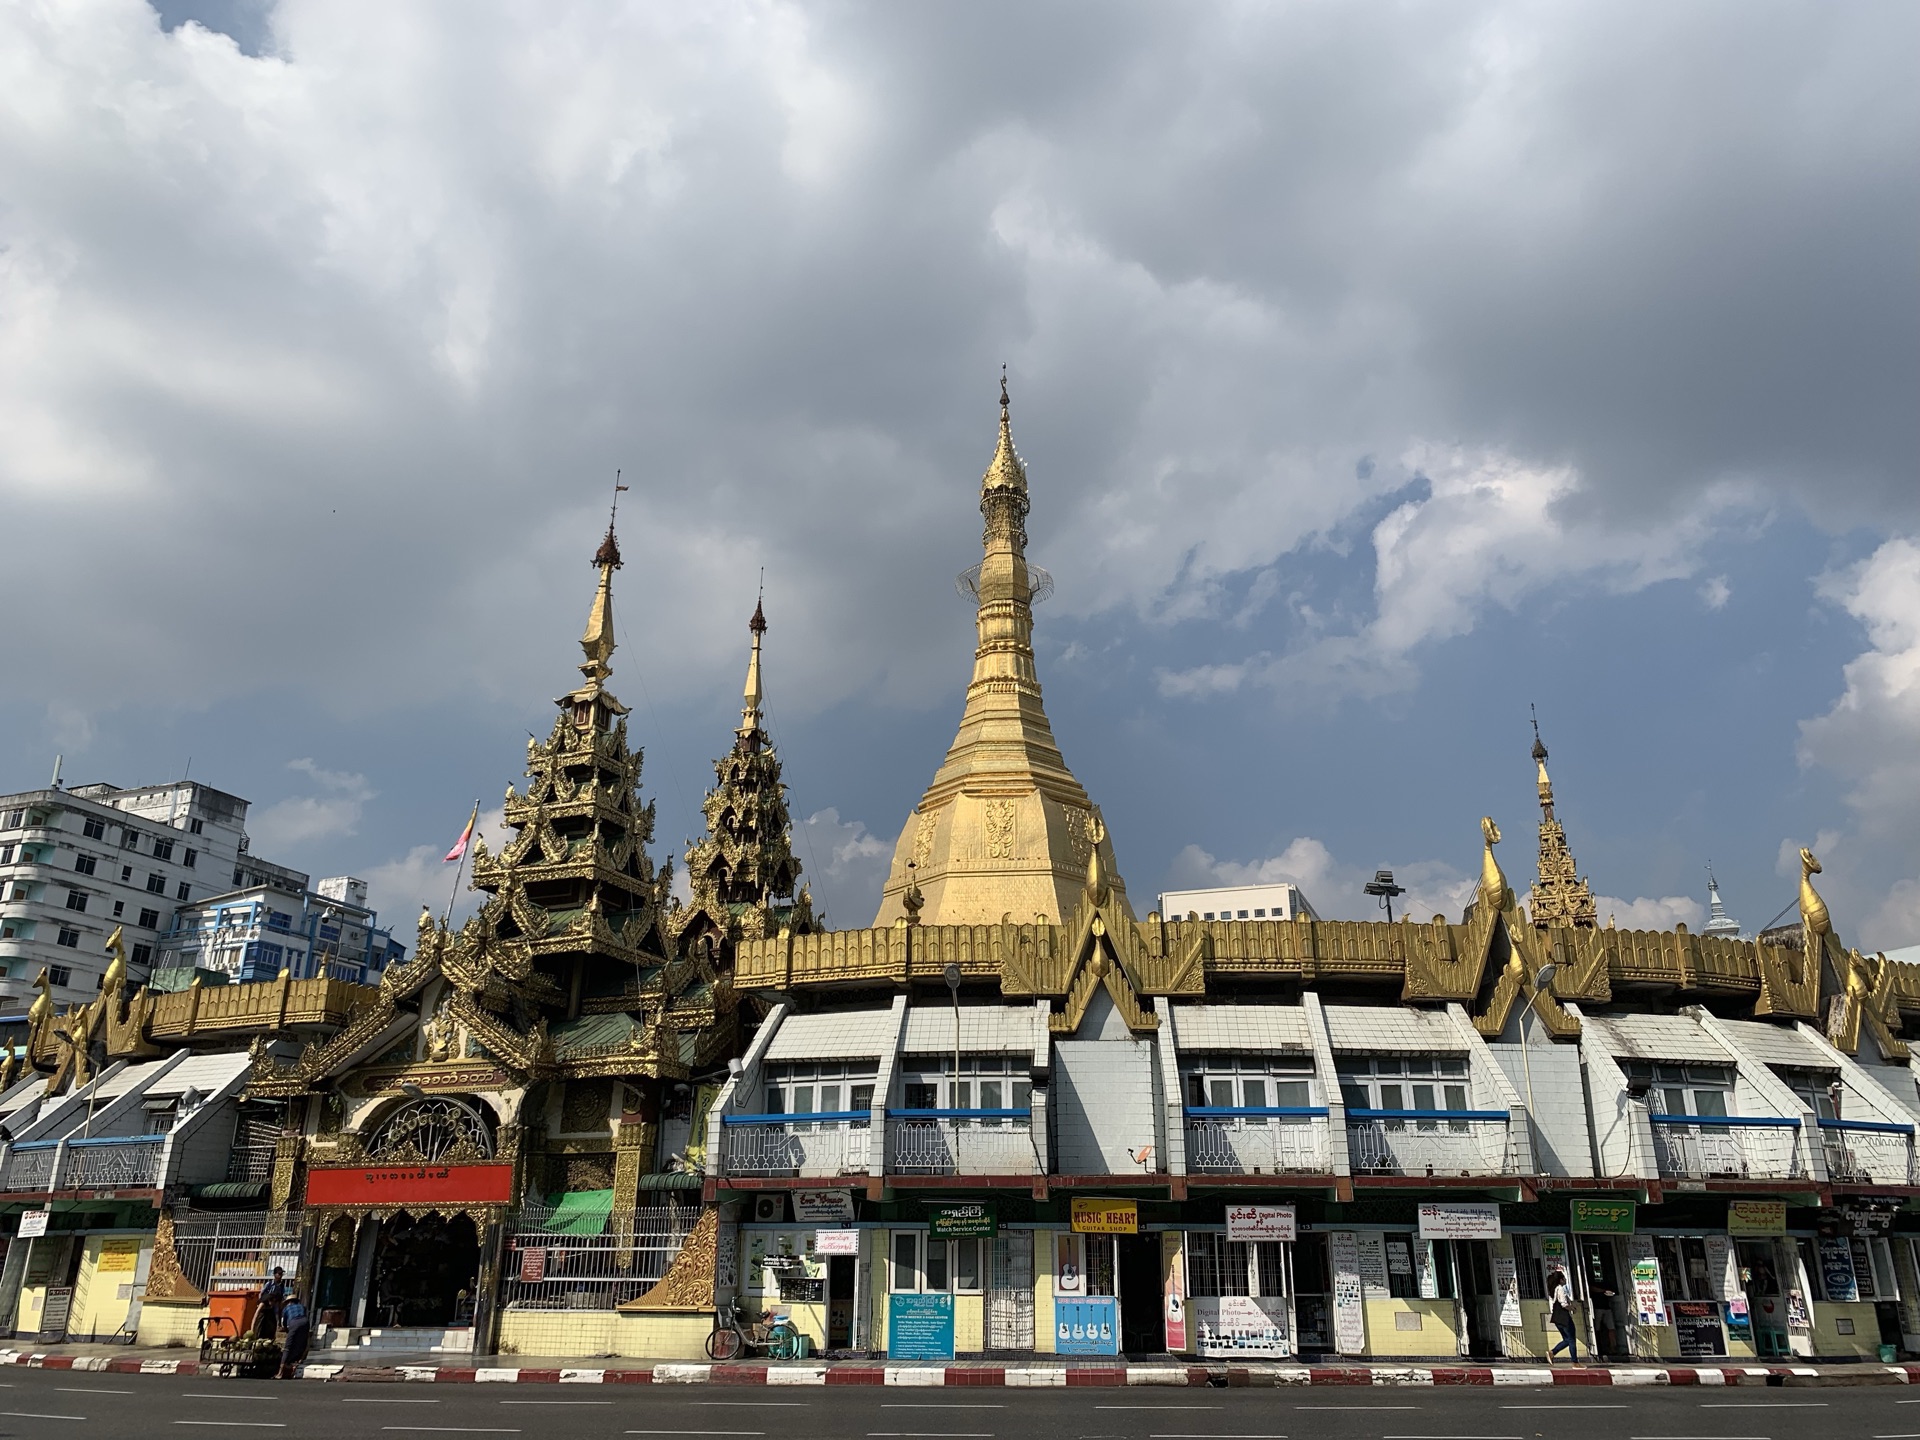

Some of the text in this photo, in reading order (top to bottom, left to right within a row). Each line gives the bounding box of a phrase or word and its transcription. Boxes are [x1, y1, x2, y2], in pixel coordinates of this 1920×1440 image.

[1073, 1211, 1136, 1225] MUSIC HEART
[1230, 1207, 1257, 1224] နှင်းဆီ
[1259, 1212, 1276, 1220] Digital
[1197, 1309, 1219, 1317] Digital
